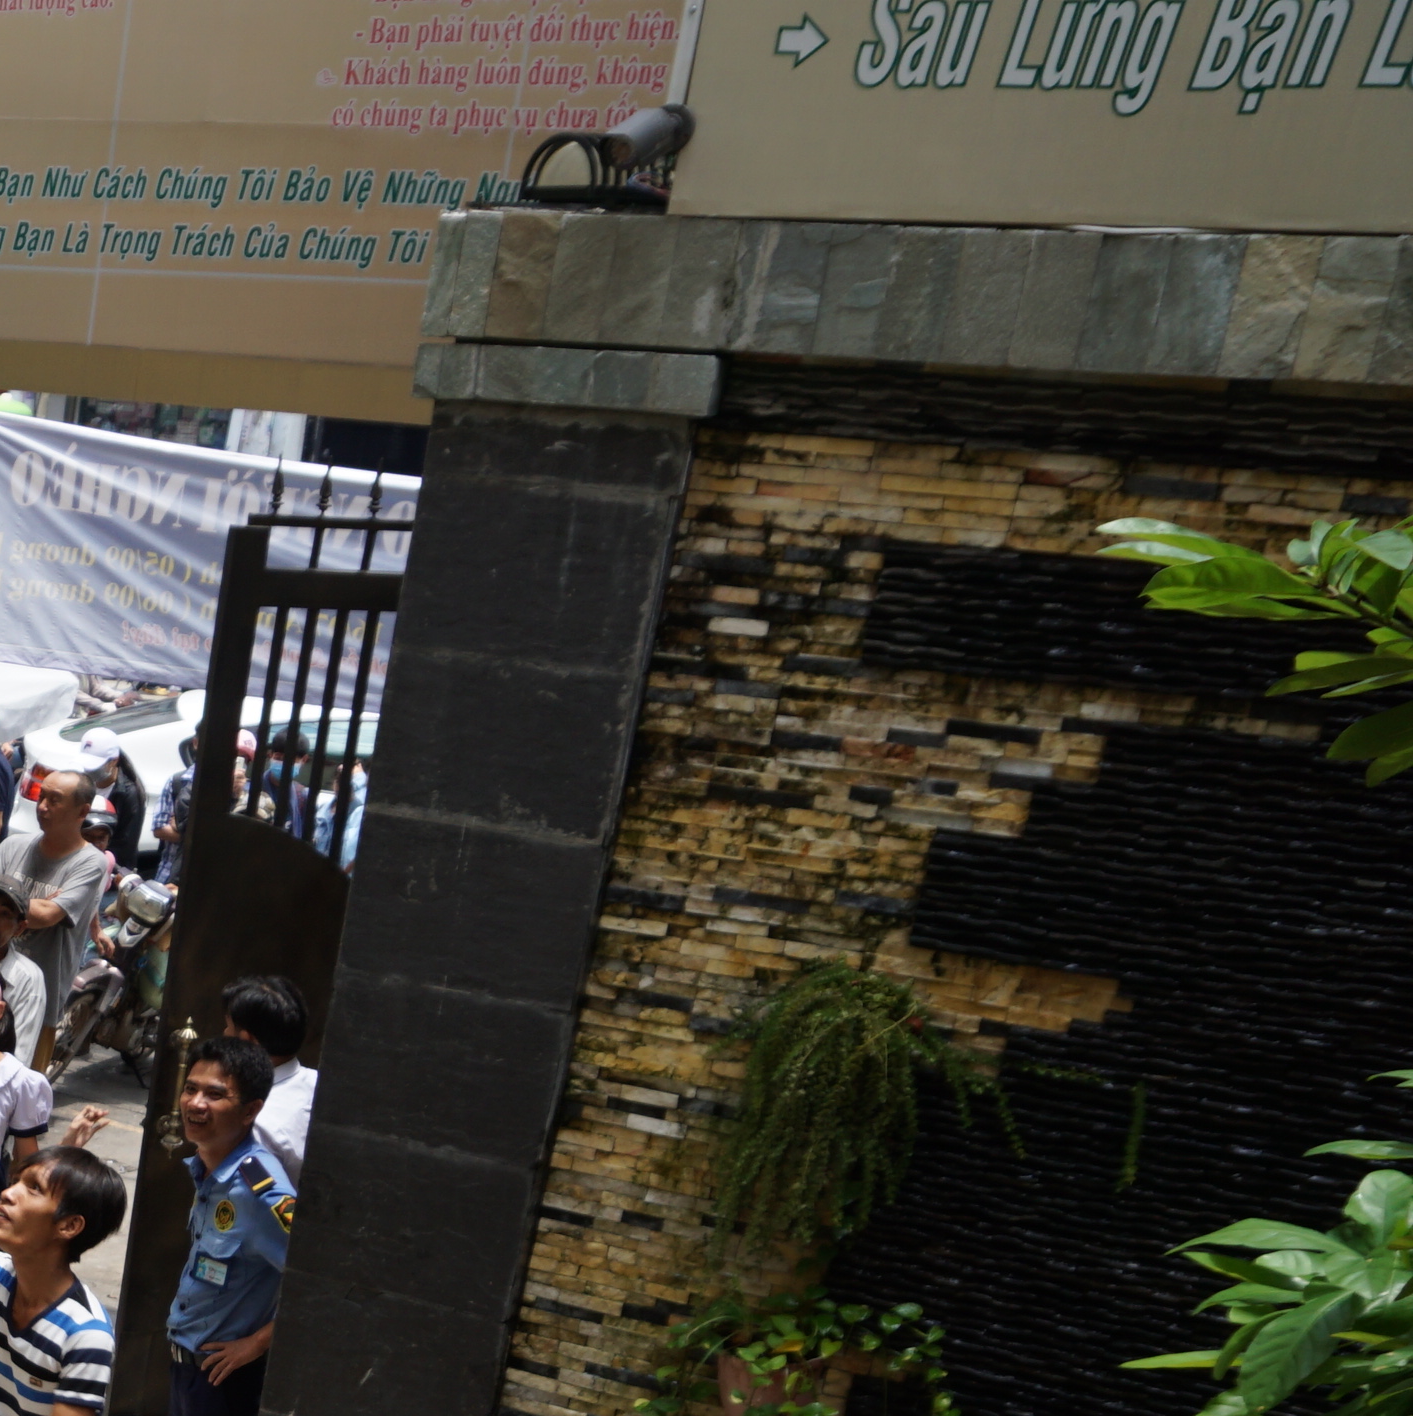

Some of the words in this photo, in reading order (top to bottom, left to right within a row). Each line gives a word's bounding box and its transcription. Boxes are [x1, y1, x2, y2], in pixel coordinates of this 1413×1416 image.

[369, 16, 411, 51] Bạn
[415, 14, 465, 51] phải
[469, 14, 525, 51] tuyệt
[529, 4, 565, 43] đối
[570, 16, 621, 50] thực
[343, 56, 411, 87] Khách
[417, 55, 471, 93] hàng
[475, 56, 522, 87] luôn
[528, 53, 588, 93] đúng,
[594, 54, 670, 93] không
[854, 0, 987, 88] Sau
[996, 0, 1183, 116] Lưng
[1188, 0, 1353, 114] Bạn
[1359, 0, 1413, 88] L
[332, 99, 355, 128] có
[360, 98, 422, 135] chúng
[428, 102, 448, 129] ta
[452, 100, 507, 136] phục
[513, 106, 537, 136] vụ
[545, 100, 597, 130] chưa
[41, 166, 89, 199] Như
[93, 166, 147, 200] Cách
[155, 165, 228, 208] Chúng
[239, 168, 275, 201] Tôi
[283, 165, 331, 203] Bảo
[343, 170, 374, 213] Vệ
[382, 169, 466, 211] Những
[12, 220, 55, 258] Bạn
[62, 221, 89, 254] Là
[101, 223, 162, 261] Trọng
[171, 223, 236, 258] Trách
[243, 222, 290, 260] Của
[298, 223, 377, 268] Chúng
[387, 229, 432, 264] Tôi
